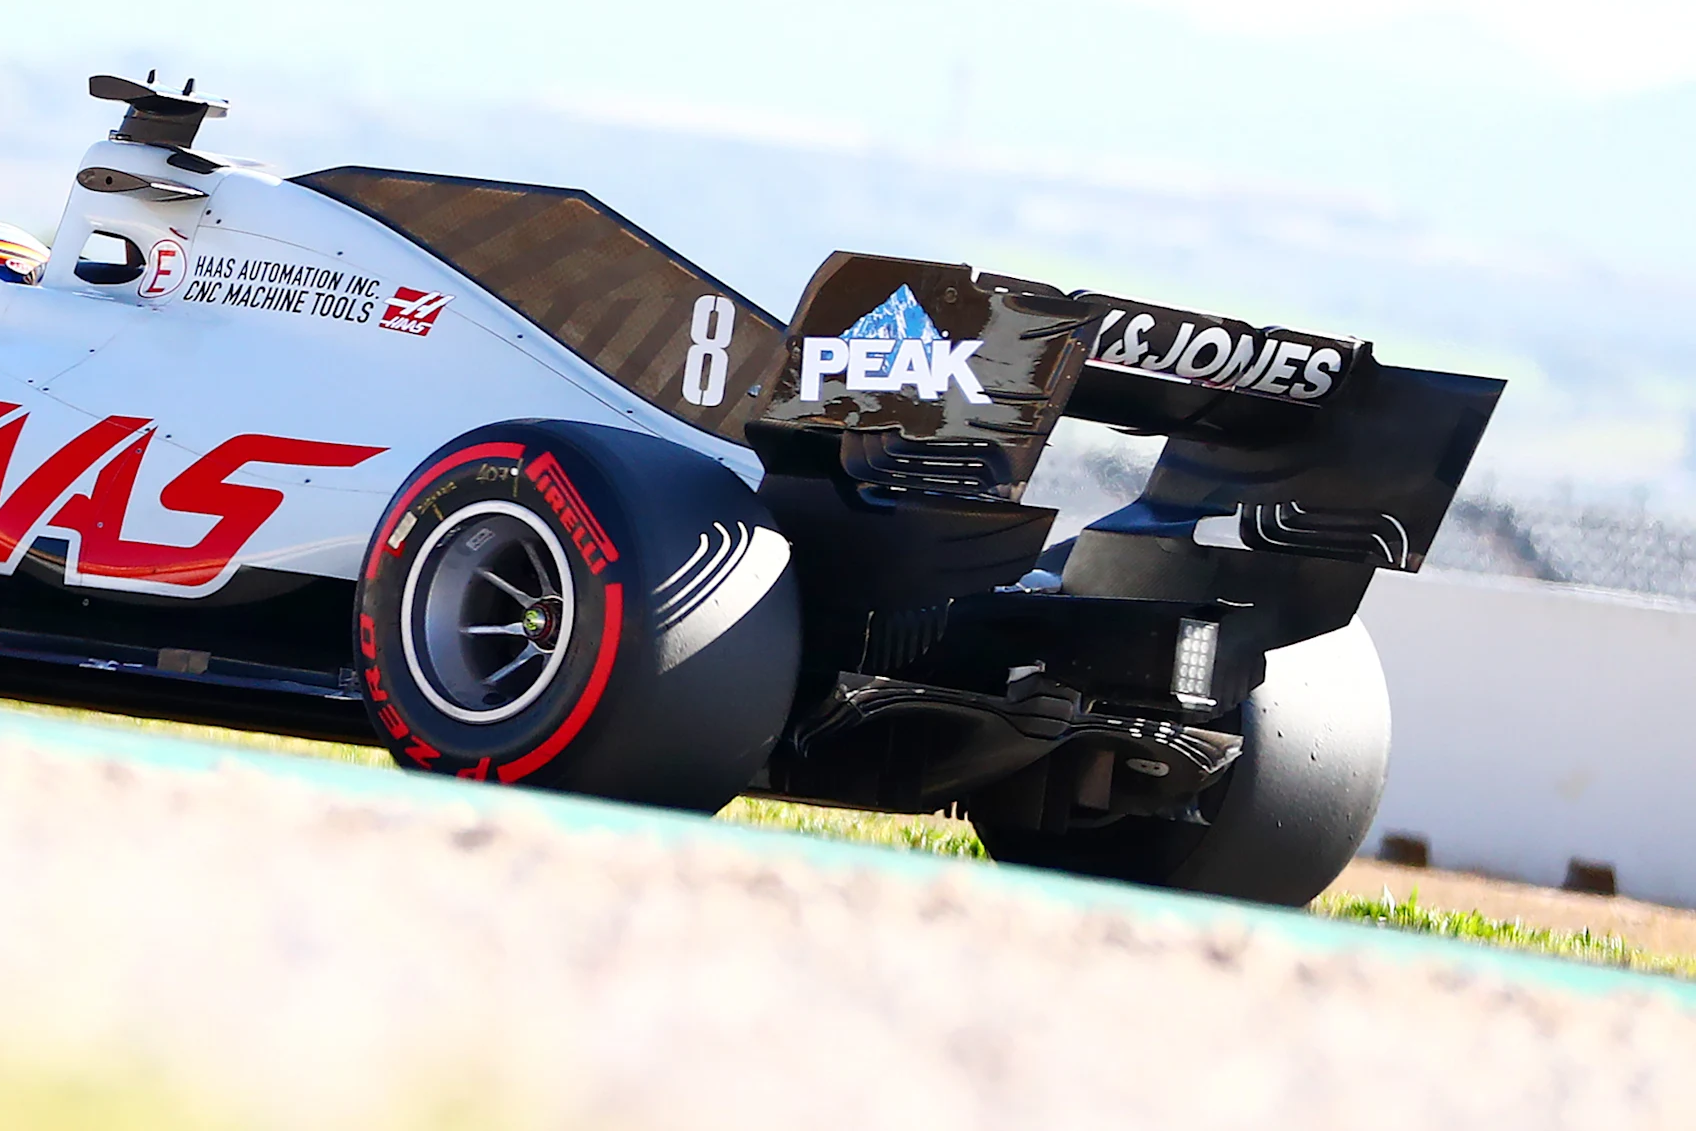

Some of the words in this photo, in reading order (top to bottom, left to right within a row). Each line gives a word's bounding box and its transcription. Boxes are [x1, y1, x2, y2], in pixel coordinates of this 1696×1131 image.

[147, 249, 176, 293] E
[194, 255, 236, 279] HAAS
[237, 260, 345, 290] AUTOMATION
[345, 275, 380, 300] INC.
[183, 281, 222, 303] CNC
[222, 284, 309, 313] MACHINE
[311, 293, 374, 324] TOOLS
[381, 316, 432, 333] HAAS
[683, 295, 736, 407] 8
[799, 338, 992, 404] PEAK
[524, 451, 620, 576] PIRELLI
[359, 614, 441, 769] ZERO
